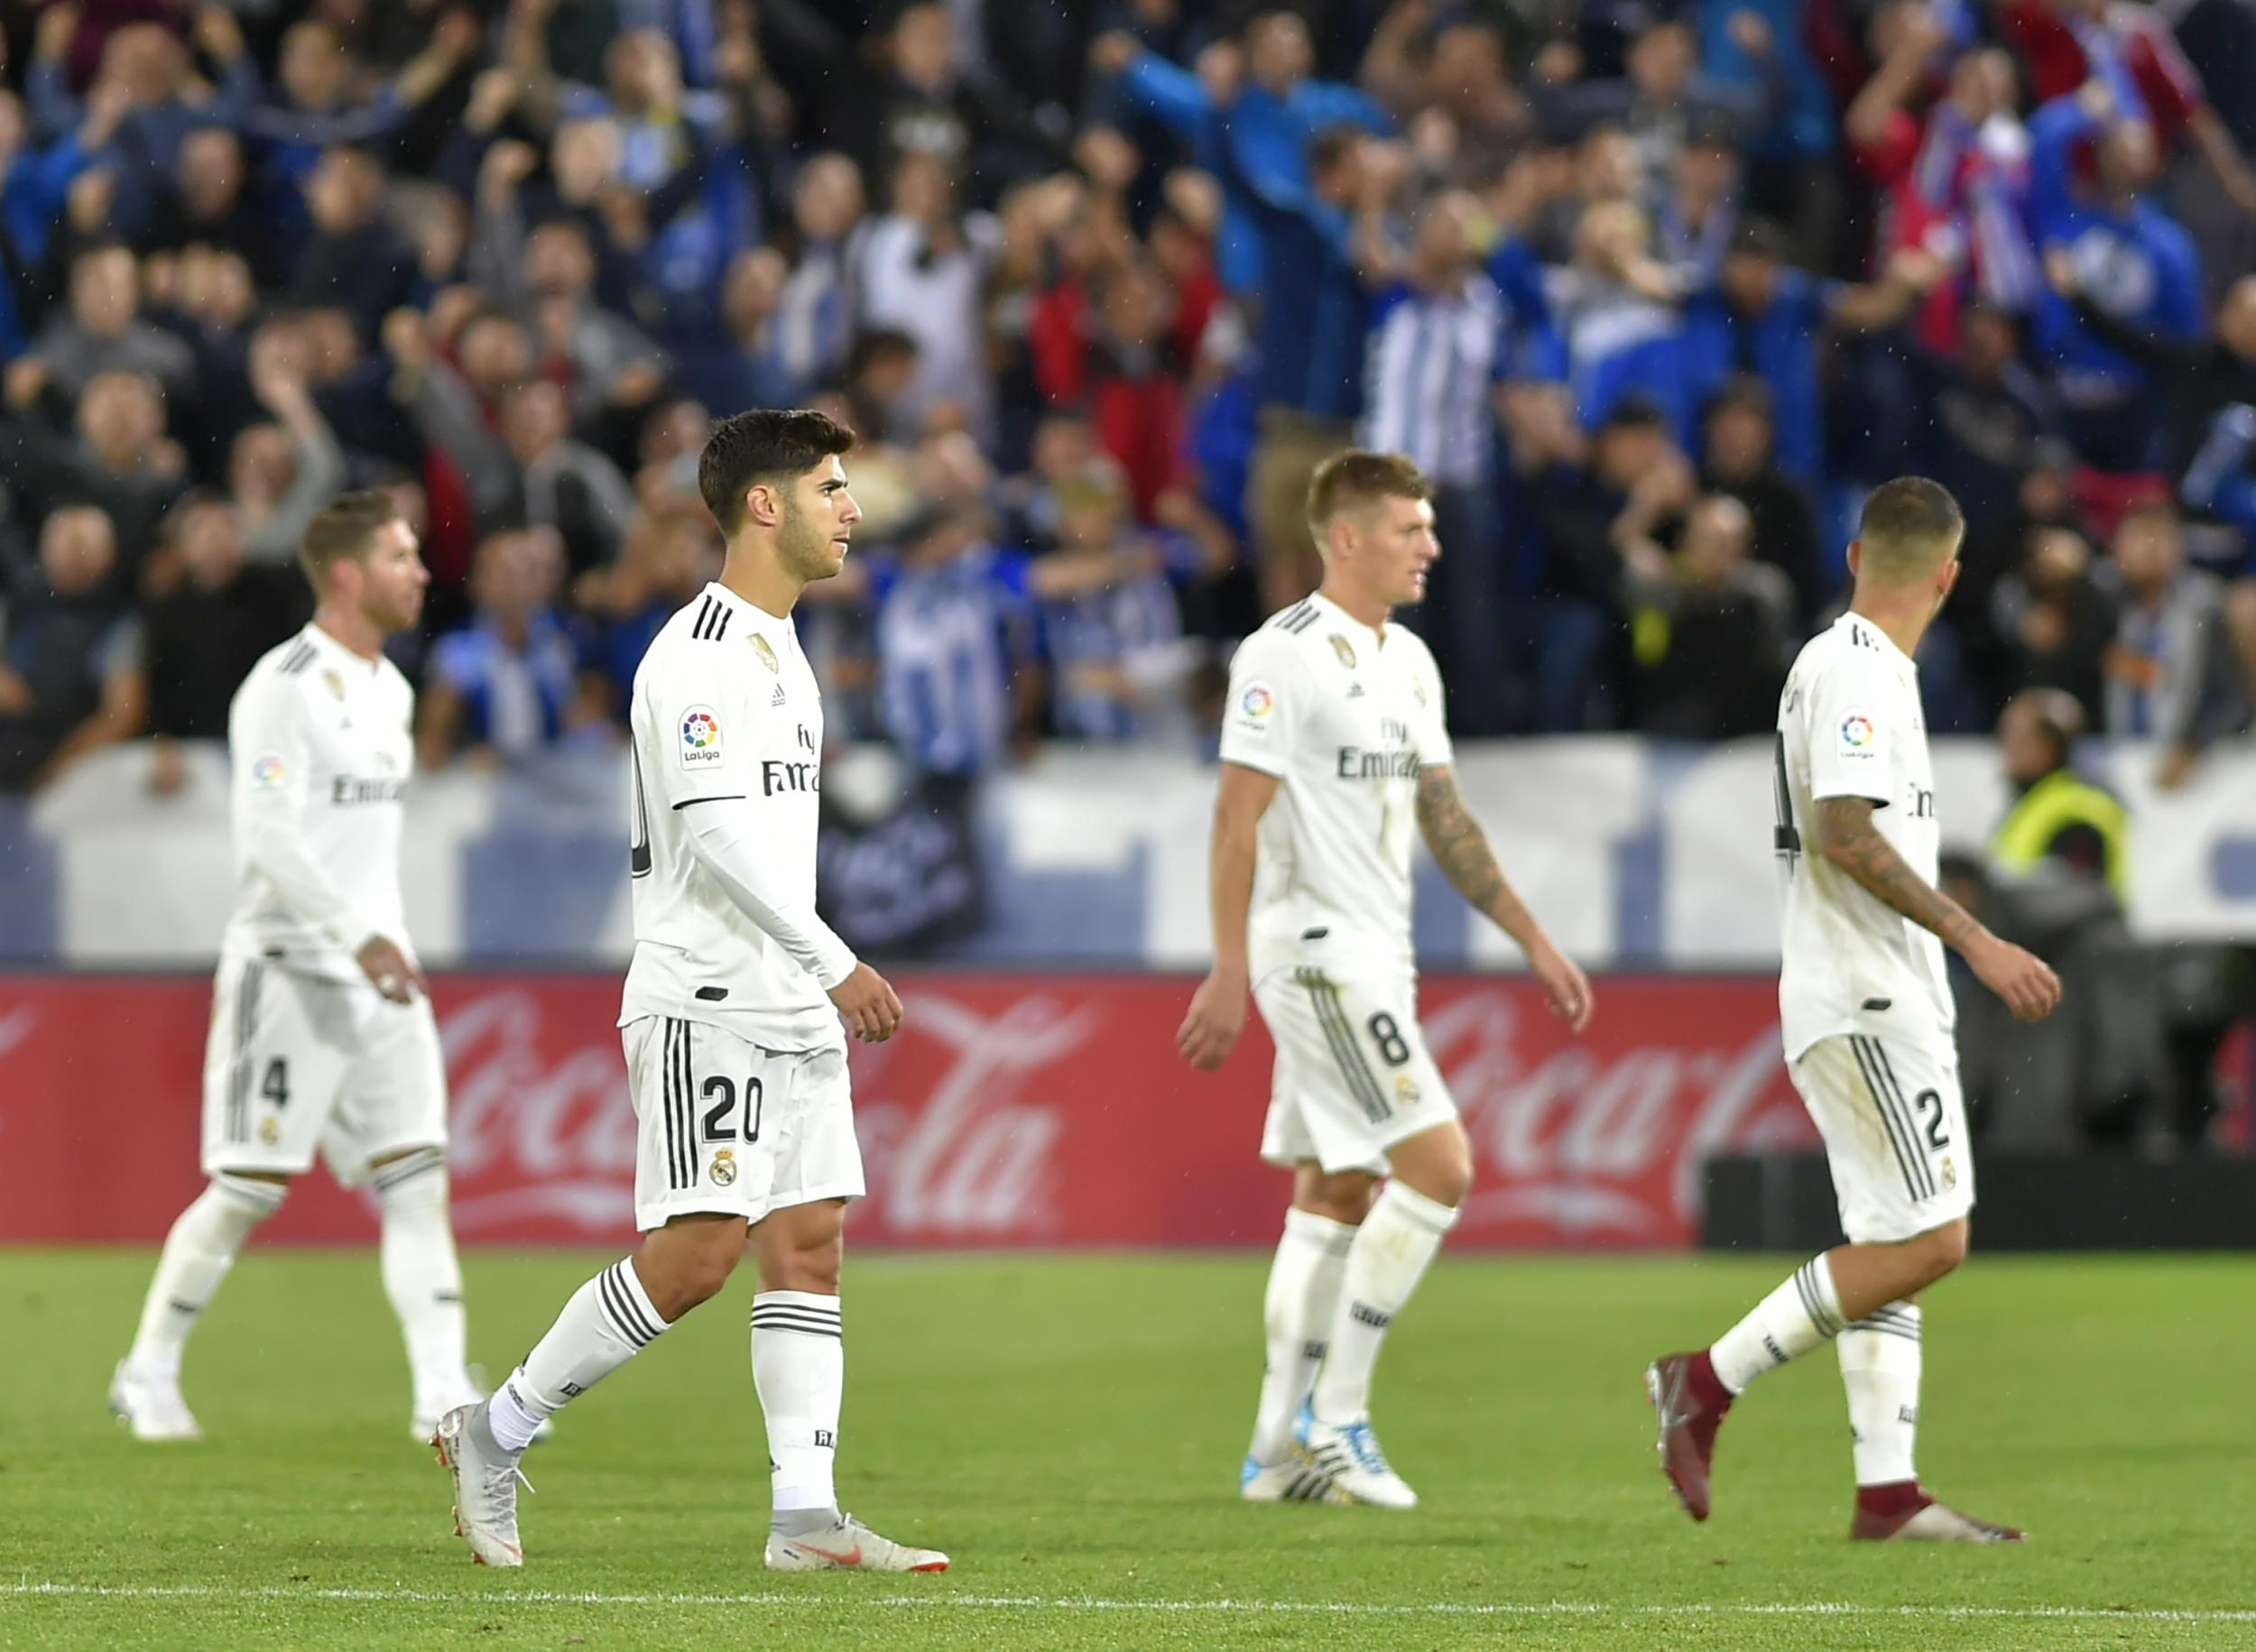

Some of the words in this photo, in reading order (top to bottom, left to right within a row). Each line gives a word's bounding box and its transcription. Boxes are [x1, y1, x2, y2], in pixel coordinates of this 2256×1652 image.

[684, 750, 720, 761] LaLiga
[1368, 1010, 1410, 1066] 8
[261, 1055, 291, 1109] 4
[699, 1075, 763, 1145] 20
[1915, 1087, 1950, 1151] 2
